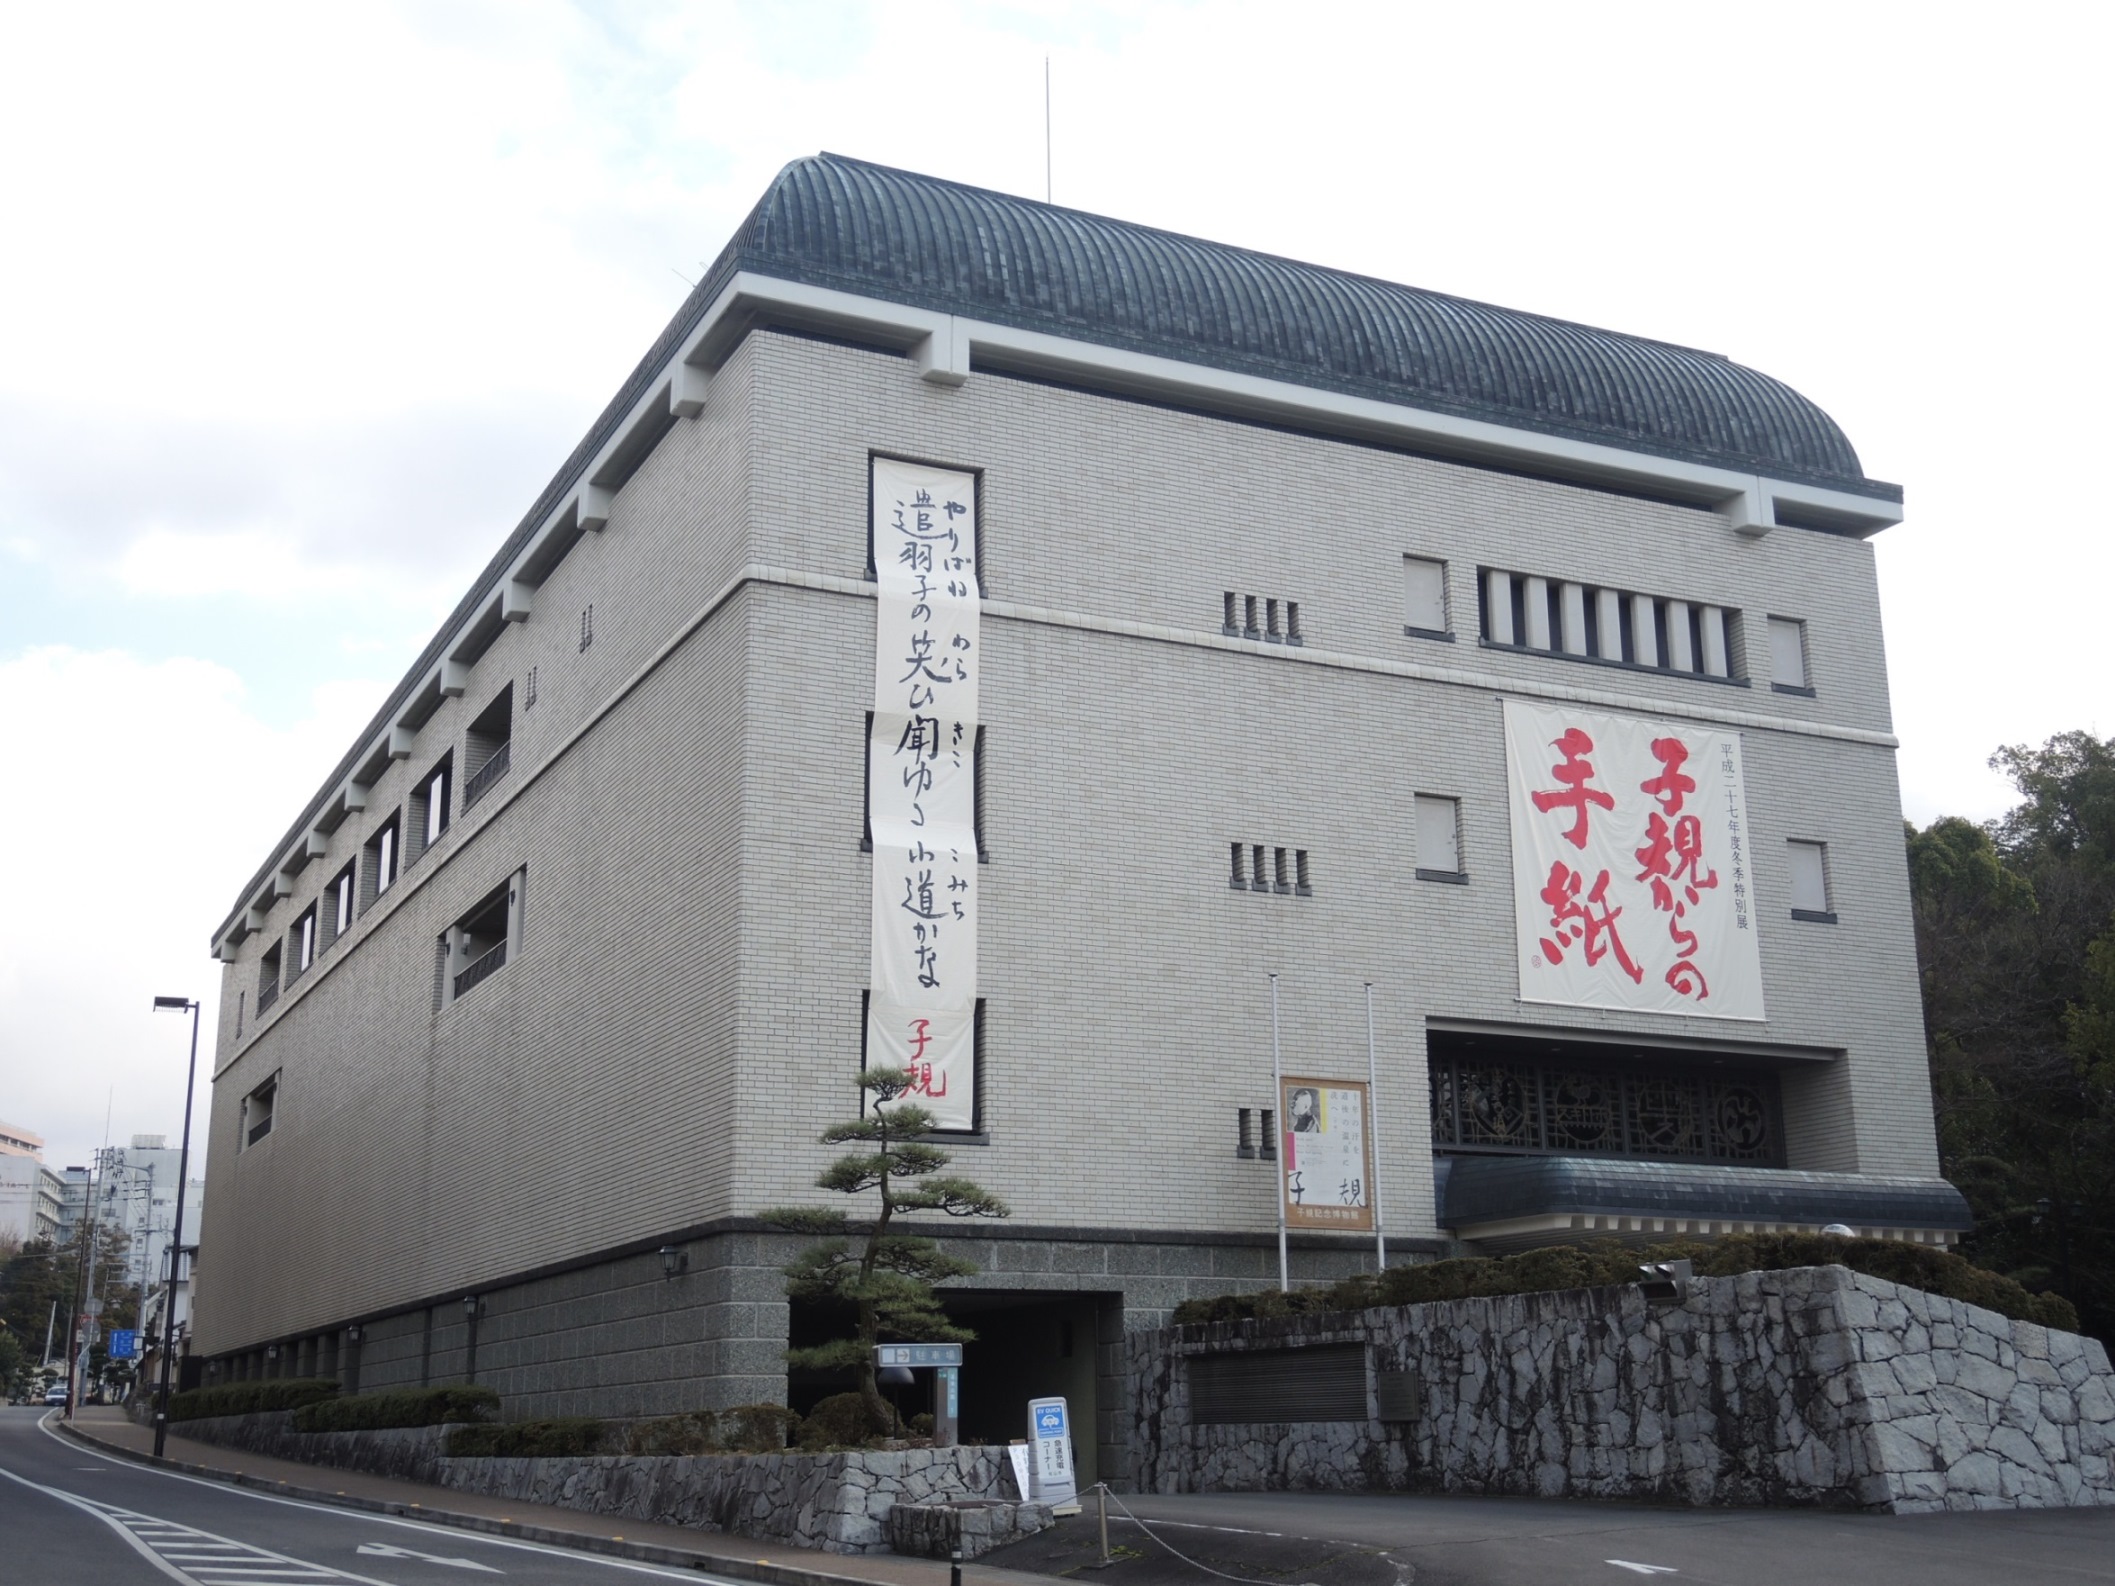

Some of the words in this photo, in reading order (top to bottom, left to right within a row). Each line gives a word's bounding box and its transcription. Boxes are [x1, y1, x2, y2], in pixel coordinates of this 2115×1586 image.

[952, 633, 971, 680] わら
[1531, 727, 1644, 985] 手紙
[1720, 743, 1749, 930] 平成二十七年度冬季特別展
[1634, 737, 1718, 1001] 子規からの
[897, 1018, 947, 1100] 子規
[915, 1349, 956, 1361] 駐車場
[1043, 1440, 1052, 1470] コーナー
[1054, 1439, 1065, 1470] 急速充電
